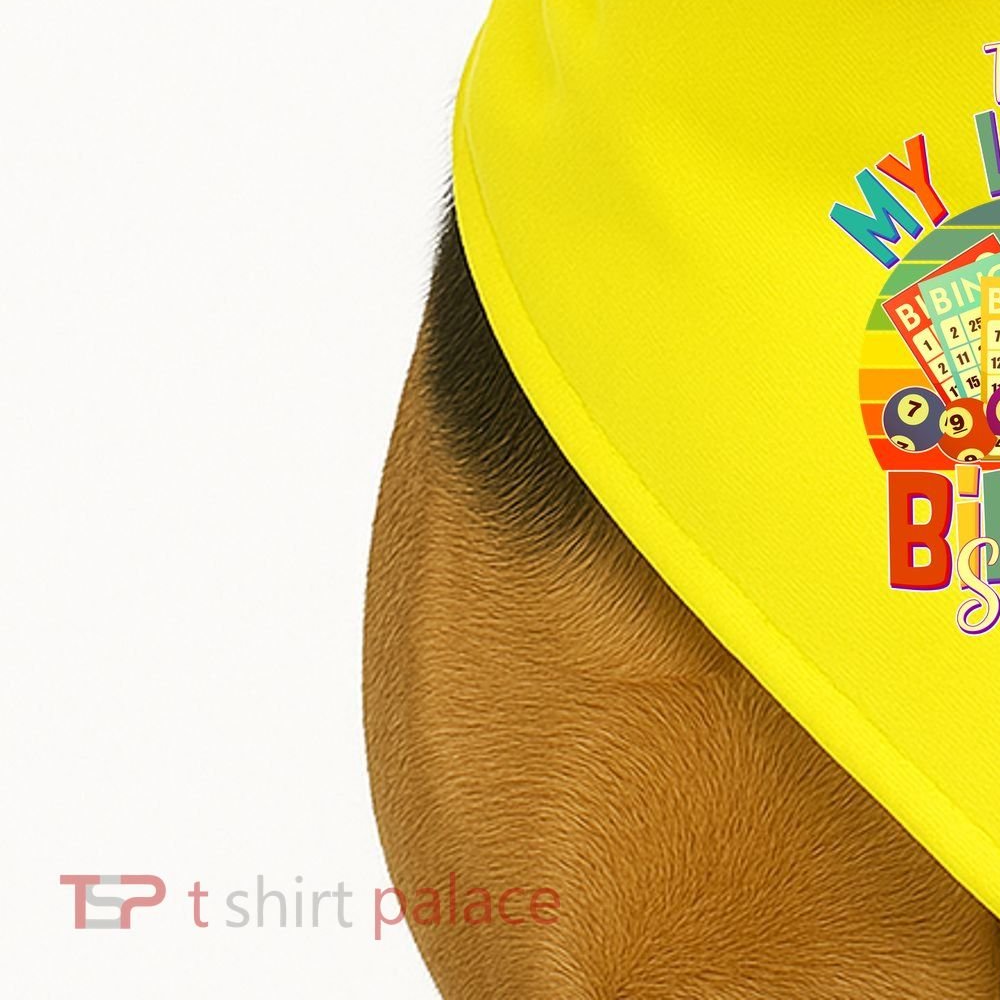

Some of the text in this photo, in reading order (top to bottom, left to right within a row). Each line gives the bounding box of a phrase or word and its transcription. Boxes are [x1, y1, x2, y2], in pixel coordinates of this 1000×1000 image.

[830, 133, 949, 269] MY
[949, 326, 960, 340] 2
[922, 339, 933, 352] 1
[955, 350, 971, 366] 11
[937, 361, 949, 375] 2
[965, 375, 981, 390] 15
[907, 400, 922, 418] 7
[949, 413, 966, 432] 9
